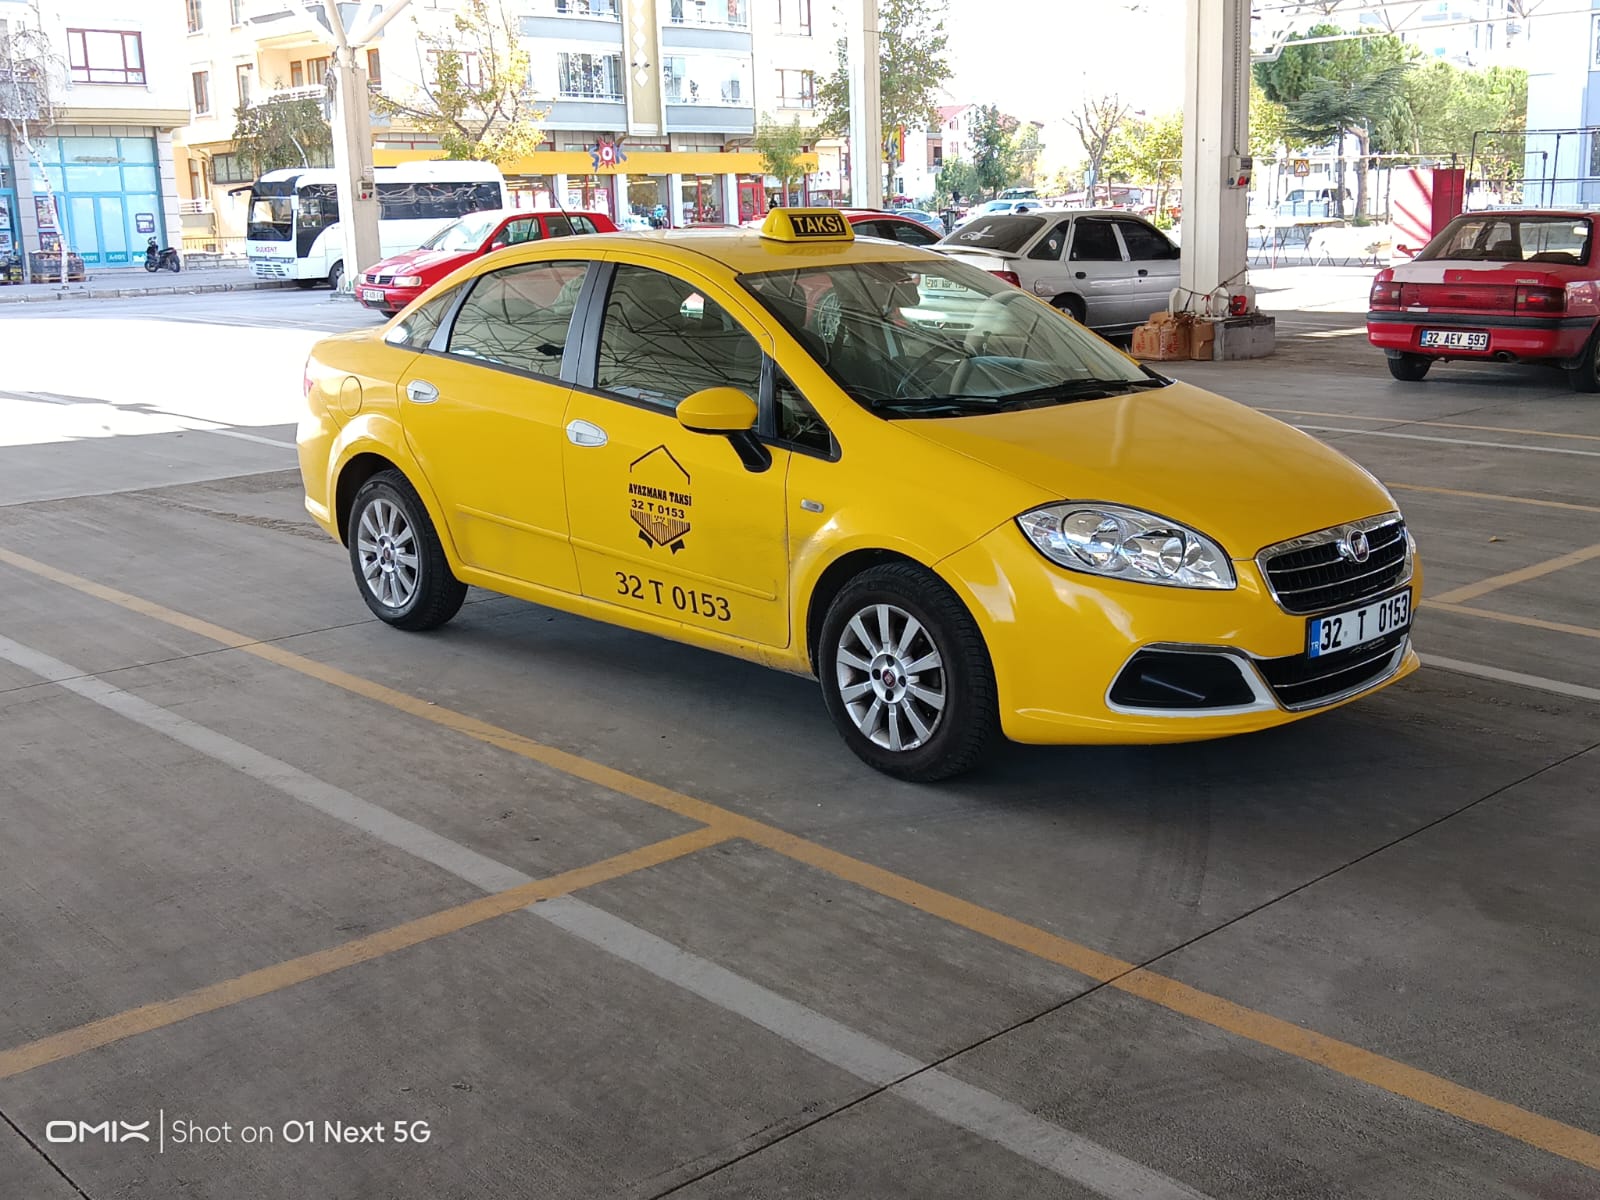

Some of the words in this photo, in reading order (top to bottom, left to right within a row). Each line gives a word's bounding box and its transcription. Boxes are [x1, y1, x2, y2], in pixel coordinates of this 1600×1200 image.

[1427, 333, 1439, 343] 32
[1444, 333, 1462, 344] AEV
[1467, 334, 1486, 345] 593
[629, 483, 667, 501] AYAZMANA
[631, 499, 644, 510] 32
[647, 502, 655, 512] T
[657, 504, 685, 519] 0153
[615, 571, 645, 600] 32
[648, 579, 664, 605] T
[672, 585, 732, 622] 0153
[1320, 617, 1343, 651] 32
[1358, 609, 1367, 641] T
[1379, 594, 1408, 633] 0153
